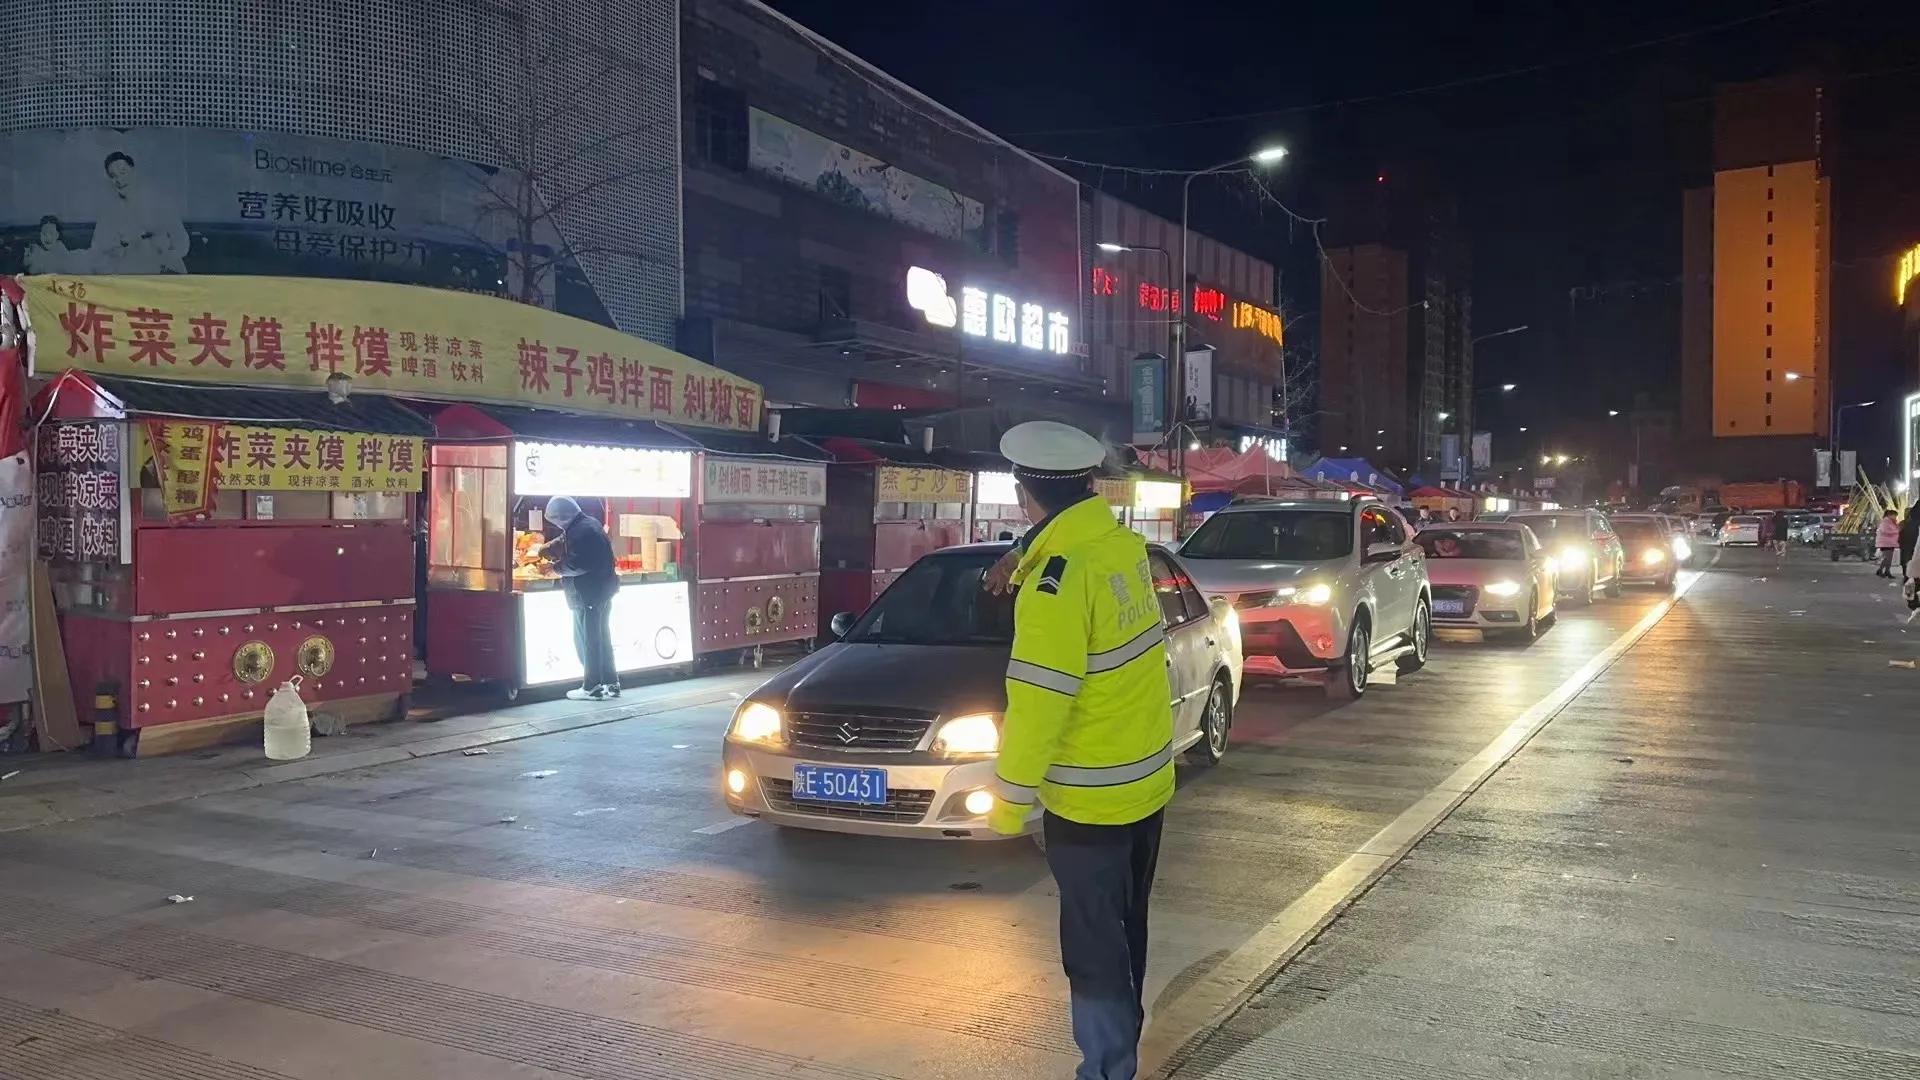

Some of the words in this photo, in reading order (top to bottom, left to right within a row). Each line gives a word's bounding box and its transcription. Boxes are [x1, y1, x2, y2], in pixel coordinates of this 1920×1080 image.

[255, 149, 345, 177] Biostime
[237, 191, 397, 231] 营养好吸收
[273, 229, 427, 267] 母爱保护力
[58, 303, 286, 371] 炸菜夹馍
[305, 321, 392, 377] 拌馍
[400, 331, 484, 360] 现拌凉菜
[401, 356, 438, 378] 啤酒
[450, 360, 485, 385] 饮料
[517, 337, 674, 416] 辣子鸡拌面
[684, 373, 757, 429] 剁椒面
[356, 436, 414, 473] 拌馍
[38, 470, 120, 511] 现拌凉菜
[287, 474, 340, 489] 现拌凉菜
[384, 476, 409, 490] 饮料
[881, 467, 971, 494] 燕子炒面
[82, 512, 119, 557] 饮料
